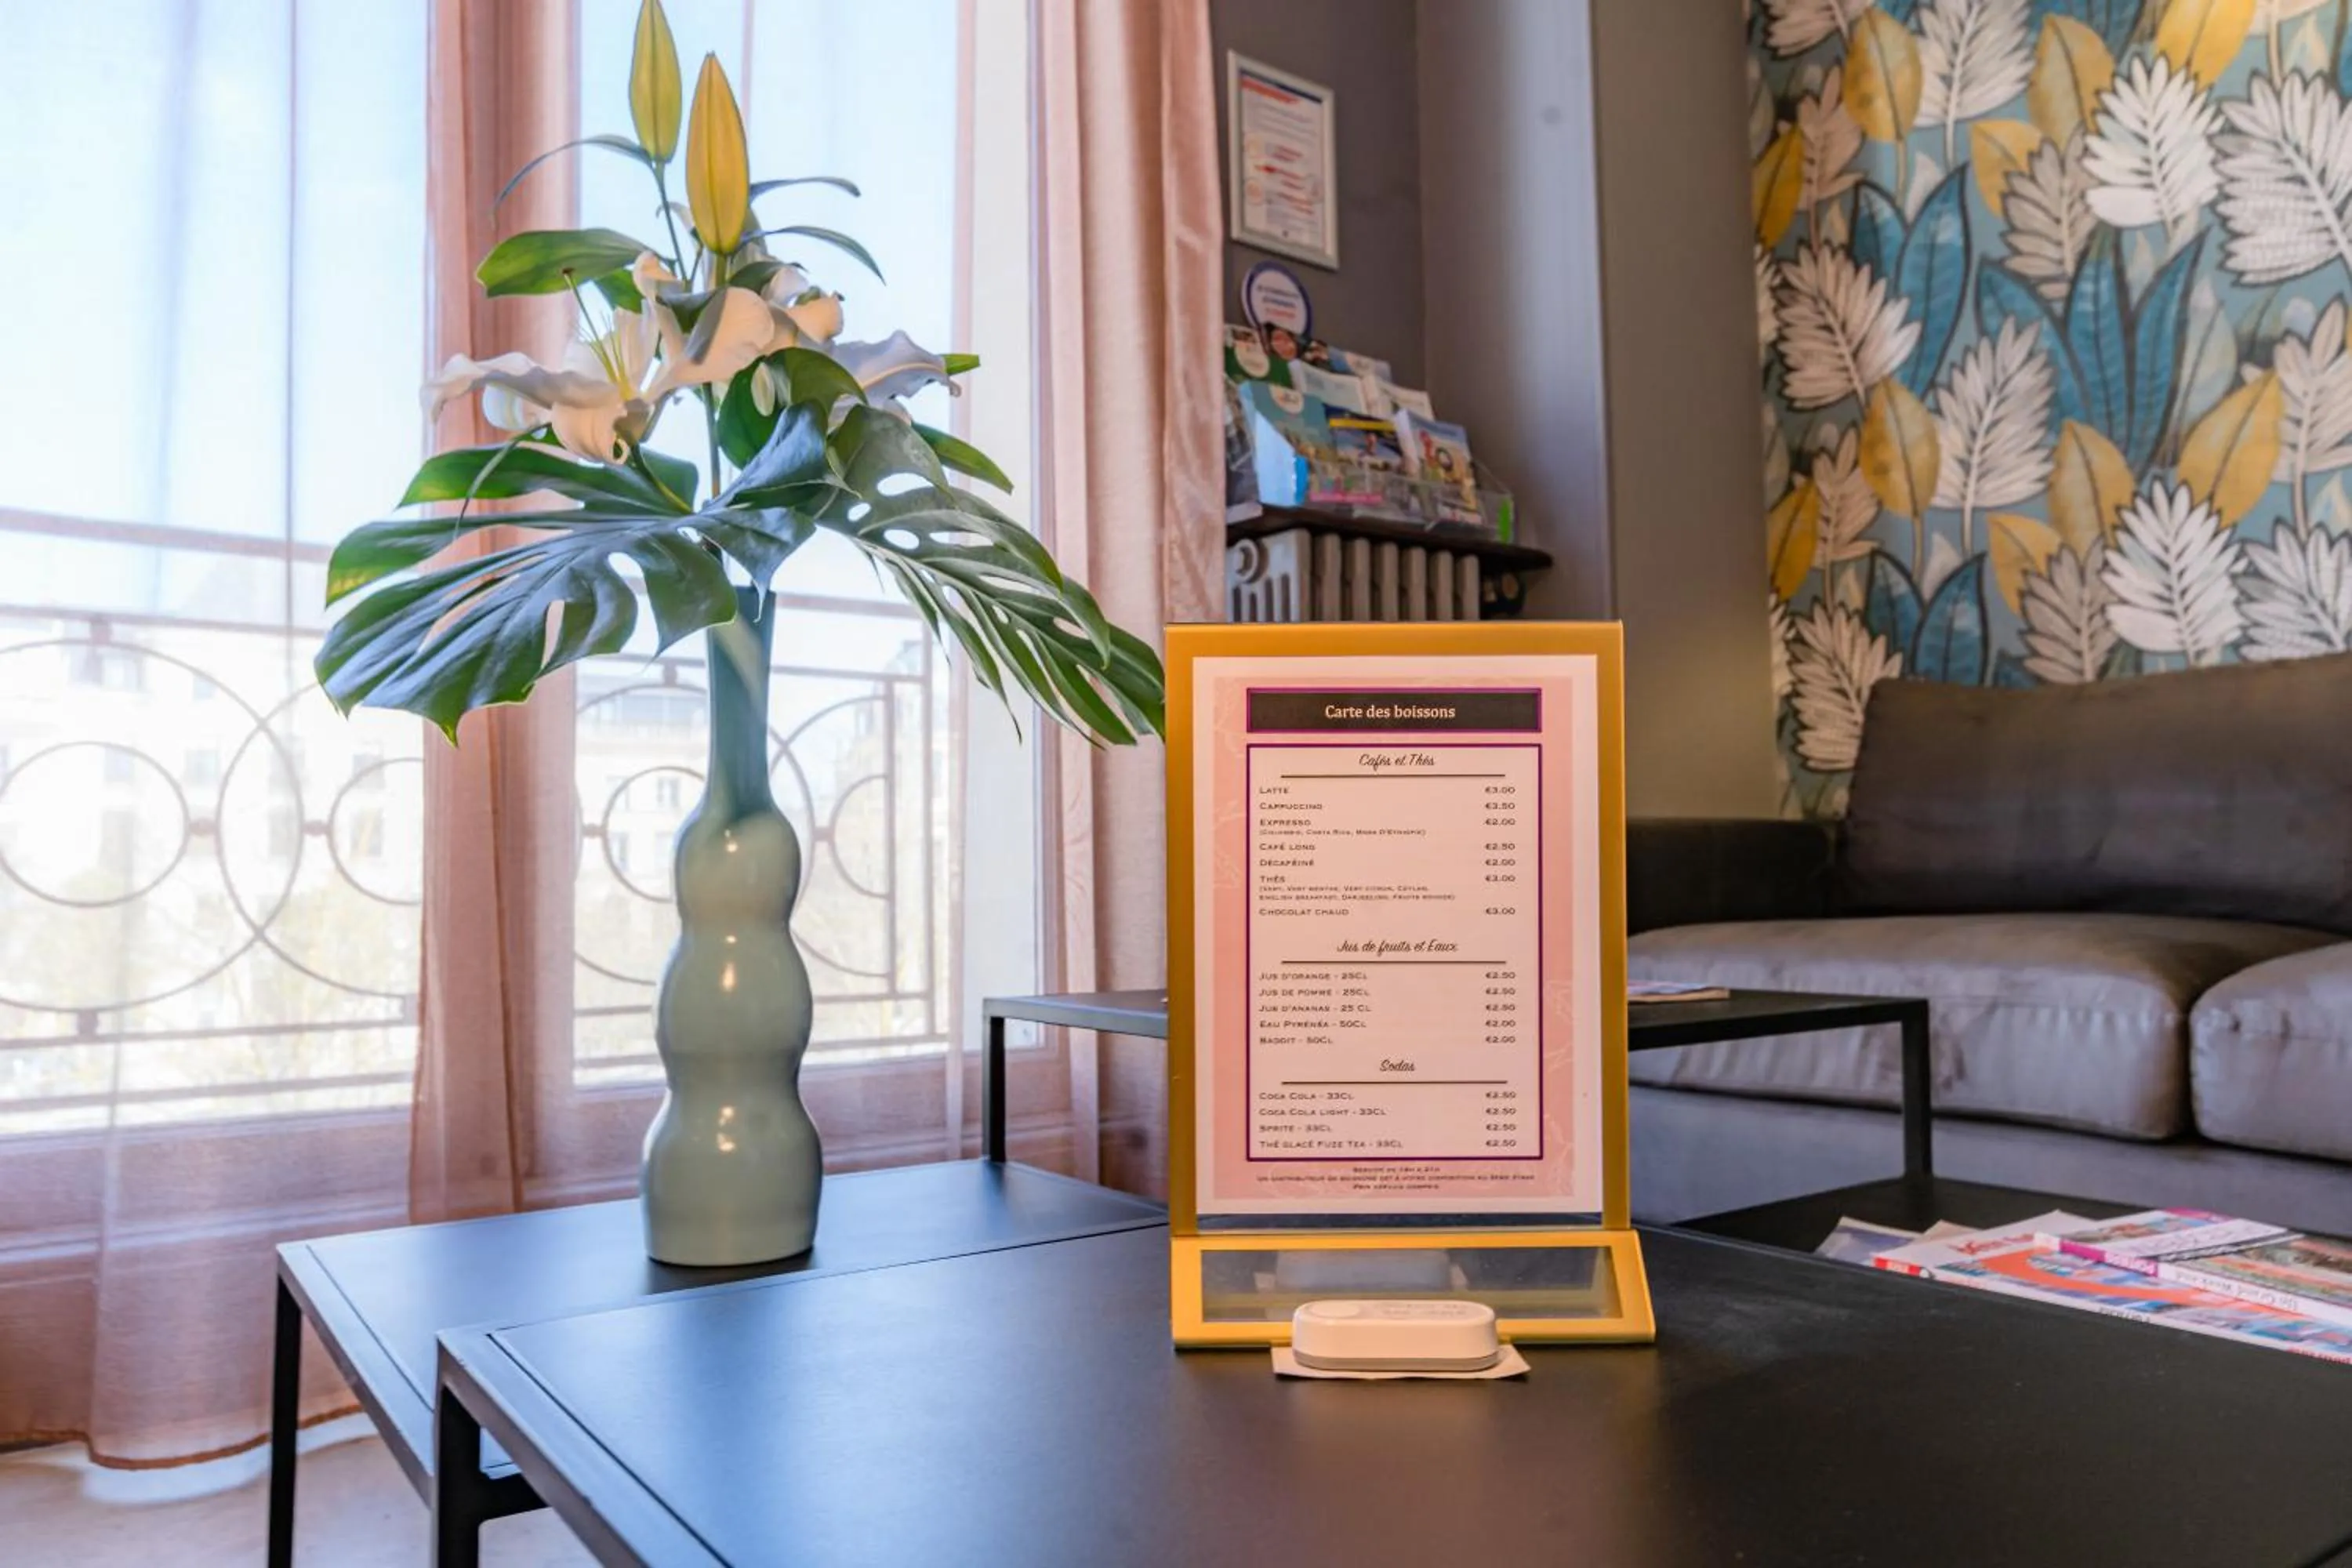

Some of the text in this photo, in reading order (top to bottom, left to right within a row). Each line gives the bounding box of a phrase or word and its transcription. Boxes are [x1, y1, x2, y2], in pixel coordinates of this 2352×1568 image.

[1325, 704, 1456, 719] Carte des boissons
[1395, 755, 1406, 766] et
[1337, 940, 1359, 953] Jus
[1362, 940, 1376, 952] de
[1414, 940, 1425, 952] et
[1380, 1058, 1415, 1072] Sodas
